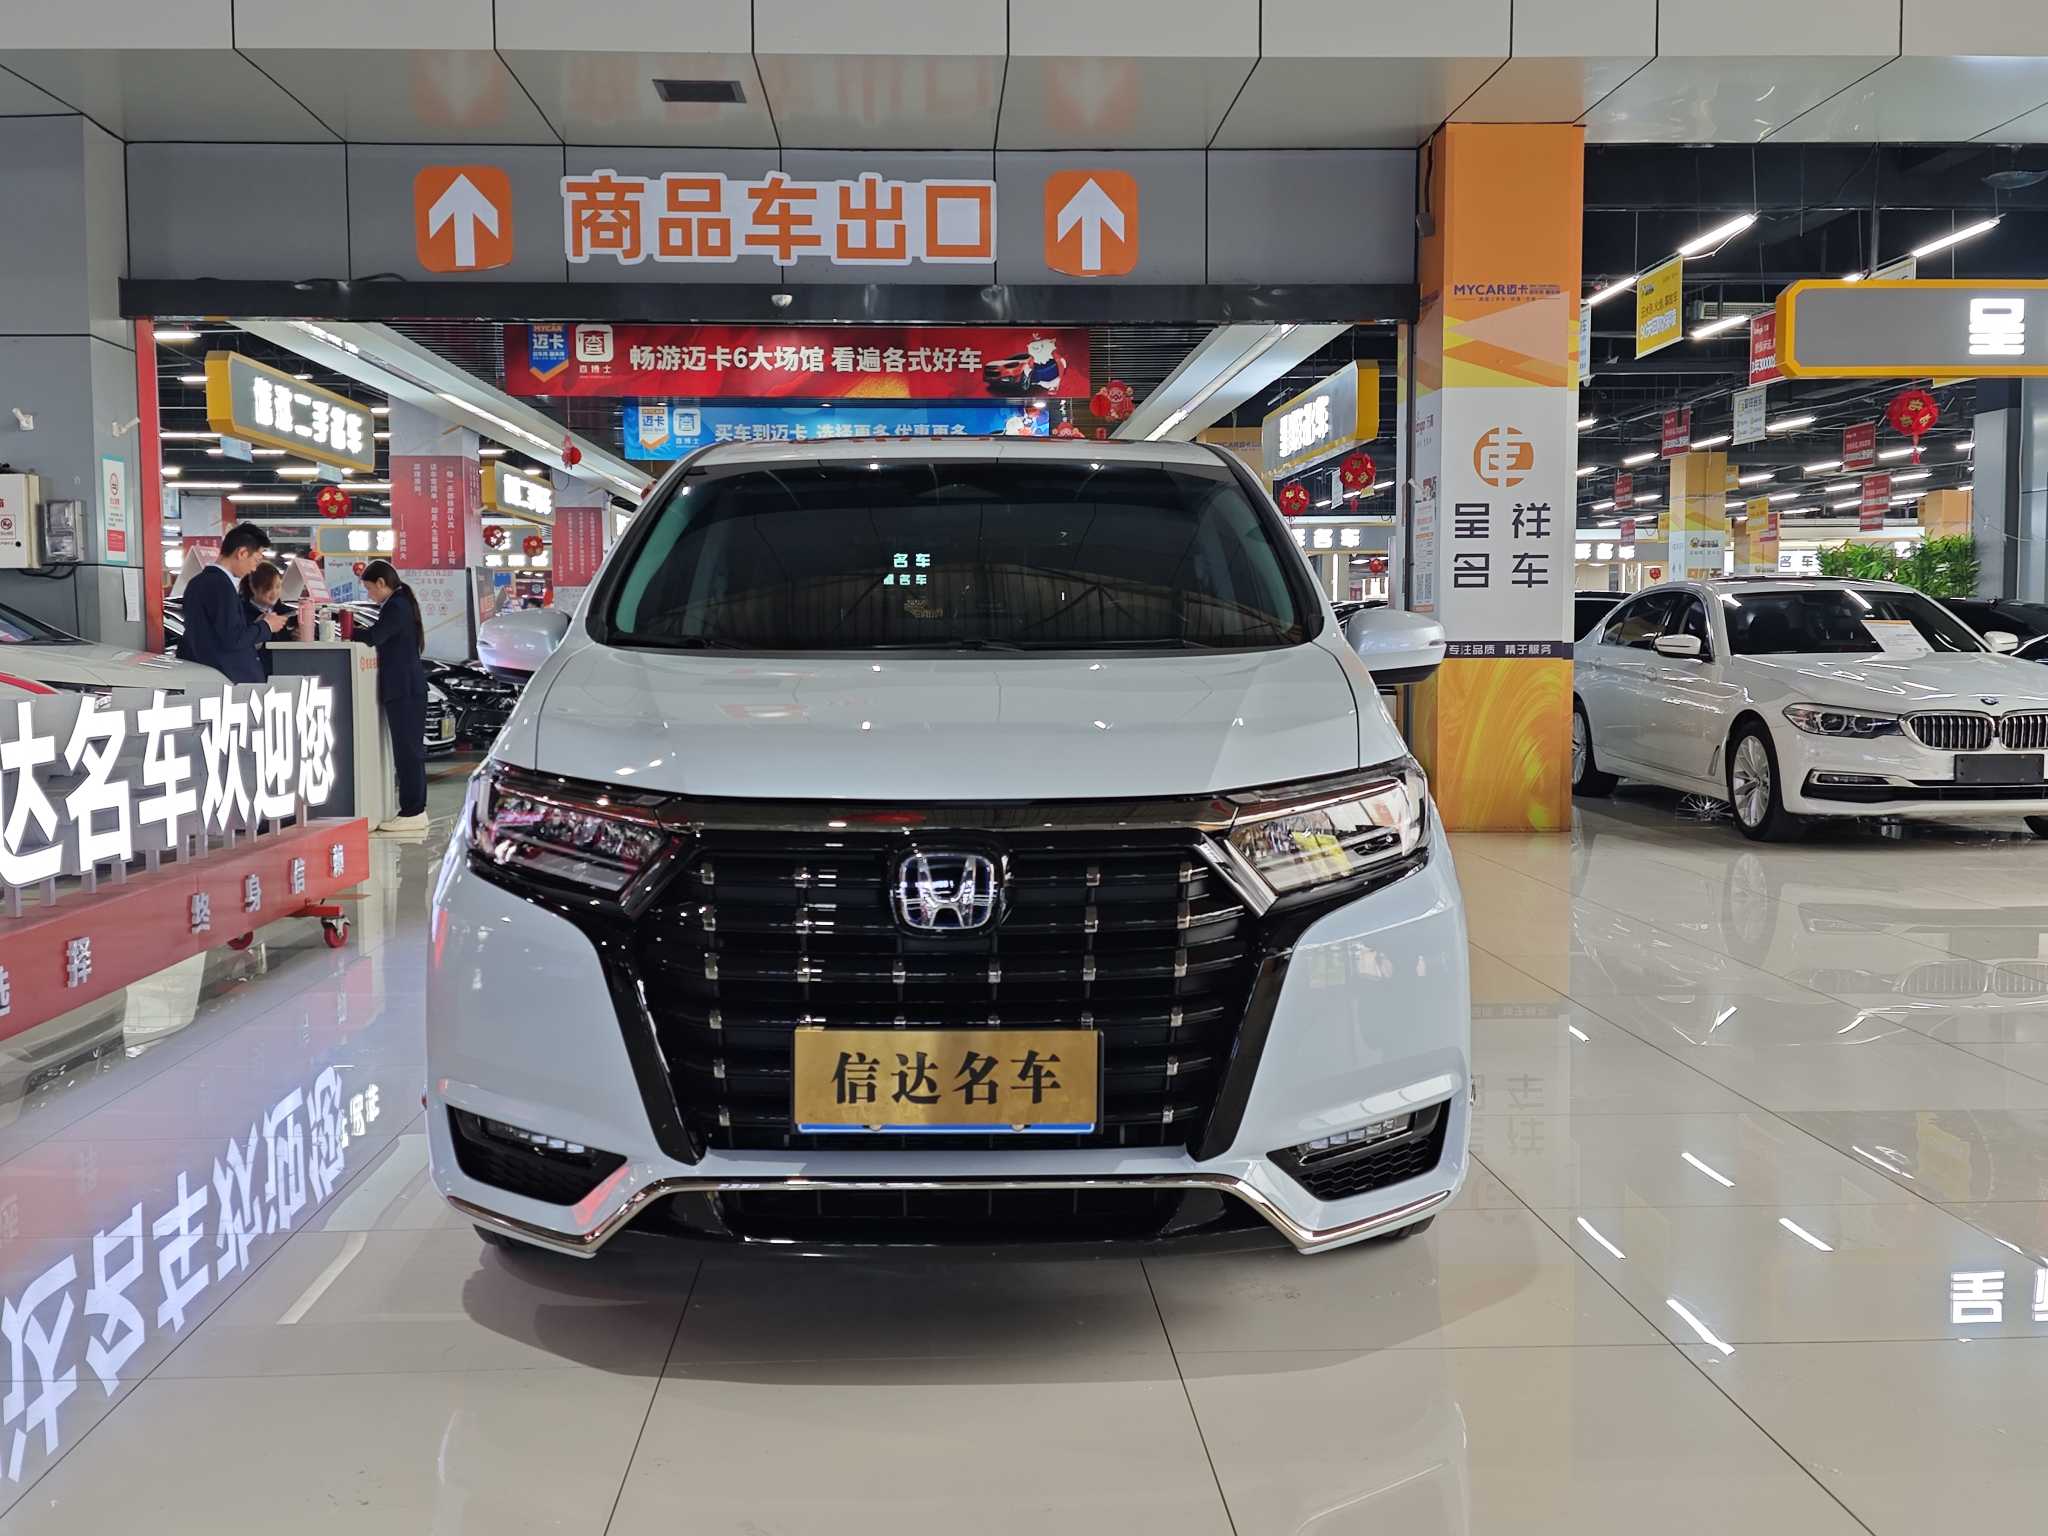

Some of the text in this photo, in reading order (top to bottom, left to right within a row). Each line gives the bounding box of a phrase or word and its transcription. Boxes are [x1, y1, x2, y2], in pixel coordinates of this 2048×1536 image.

[563, 172, 995, 264] 商品车出口
[532, 333, 565, 350] 迈卡
[1967, 297, 2026, 355] 呈
[629, 345, 983, 373] 畅游迈卡6大场馆 看遍各式好车
[714, 424, 808, 442] 买车到迈卡
[1454, 502, 1551, 539] 呈祥
[893, 553, 930, 568] 名车
[1453, 552, 1550, 588] 名车
[1448, 644, 1552, 656] 专注品质 精于服务
[831, 1049, 1061, 1105] 信达名车
